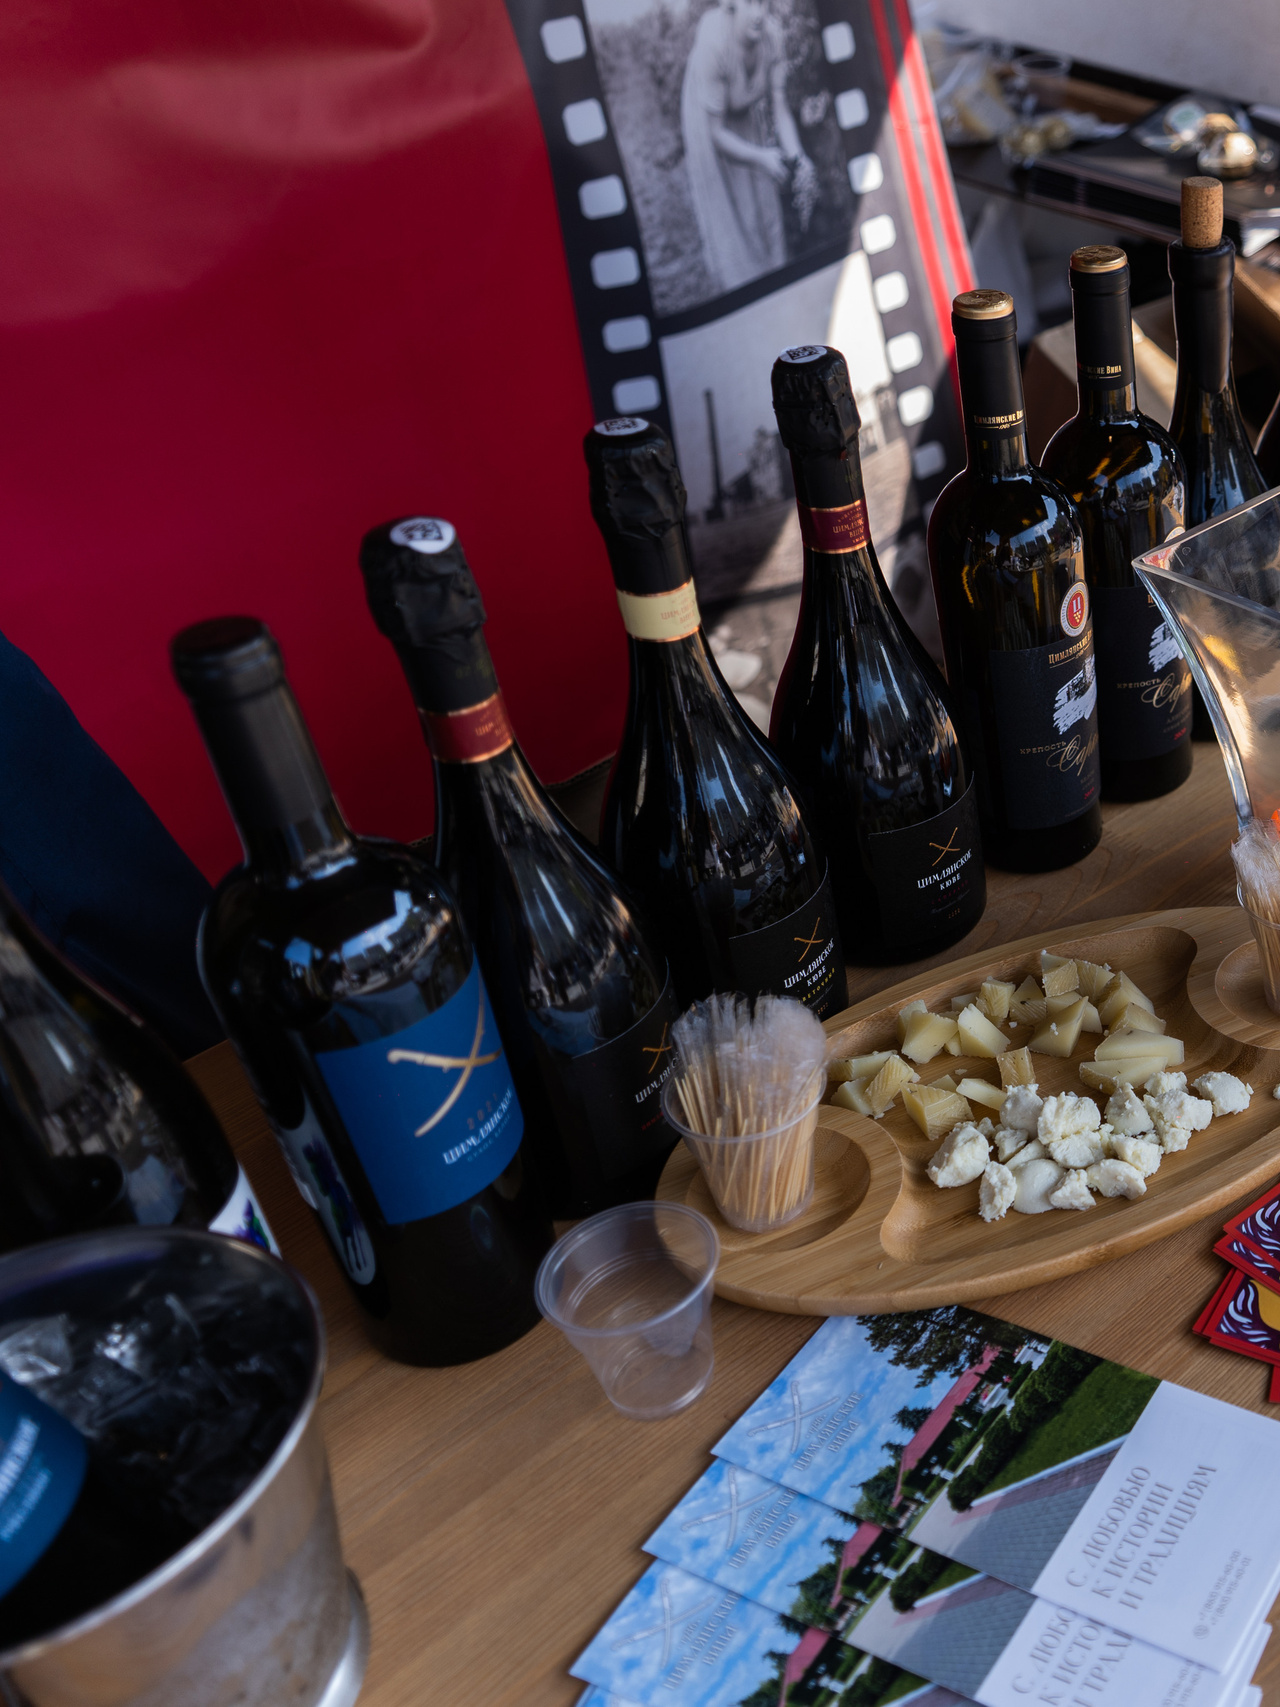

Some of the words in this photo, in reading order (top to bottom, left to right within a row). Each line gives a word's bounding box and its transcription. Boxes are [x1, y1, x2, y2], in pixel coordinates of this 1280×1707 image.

[1019, 741, 1067, 755] КРЕПОСТЬ
[917, 848, 972, 889] ЦИМЛЯНСКОЕ
[939, 872, 961, 891] КЮВЕ
[783, 937, 835, 989] ЦИМЛЯНСКОЕ
[806, 965, 827, 987] КЮВЕ
[827, 1420, 860, 1453] ВИНА
[728, 1487, 798, 1569] ЦИМЛЯНСКИ
[765, 1512, 799, 1549] ВИНА
[1066, 1568, 1089, 1588] С
[1081, 1466, 1151, 1569] ЛЮБОВЬЮ
[1103, 1481, 1174, 1578] ИСТОРИИ
[1118, 1590, 1144, 1610] И
[1131, 1465, 1218, 1586] ТРАДИЦИЯМ
[1091, 1579, 1117, 1599] К
[702, 1625, 737, 1666] ВИНА
[1011, 1674, 1036, 1695] С
